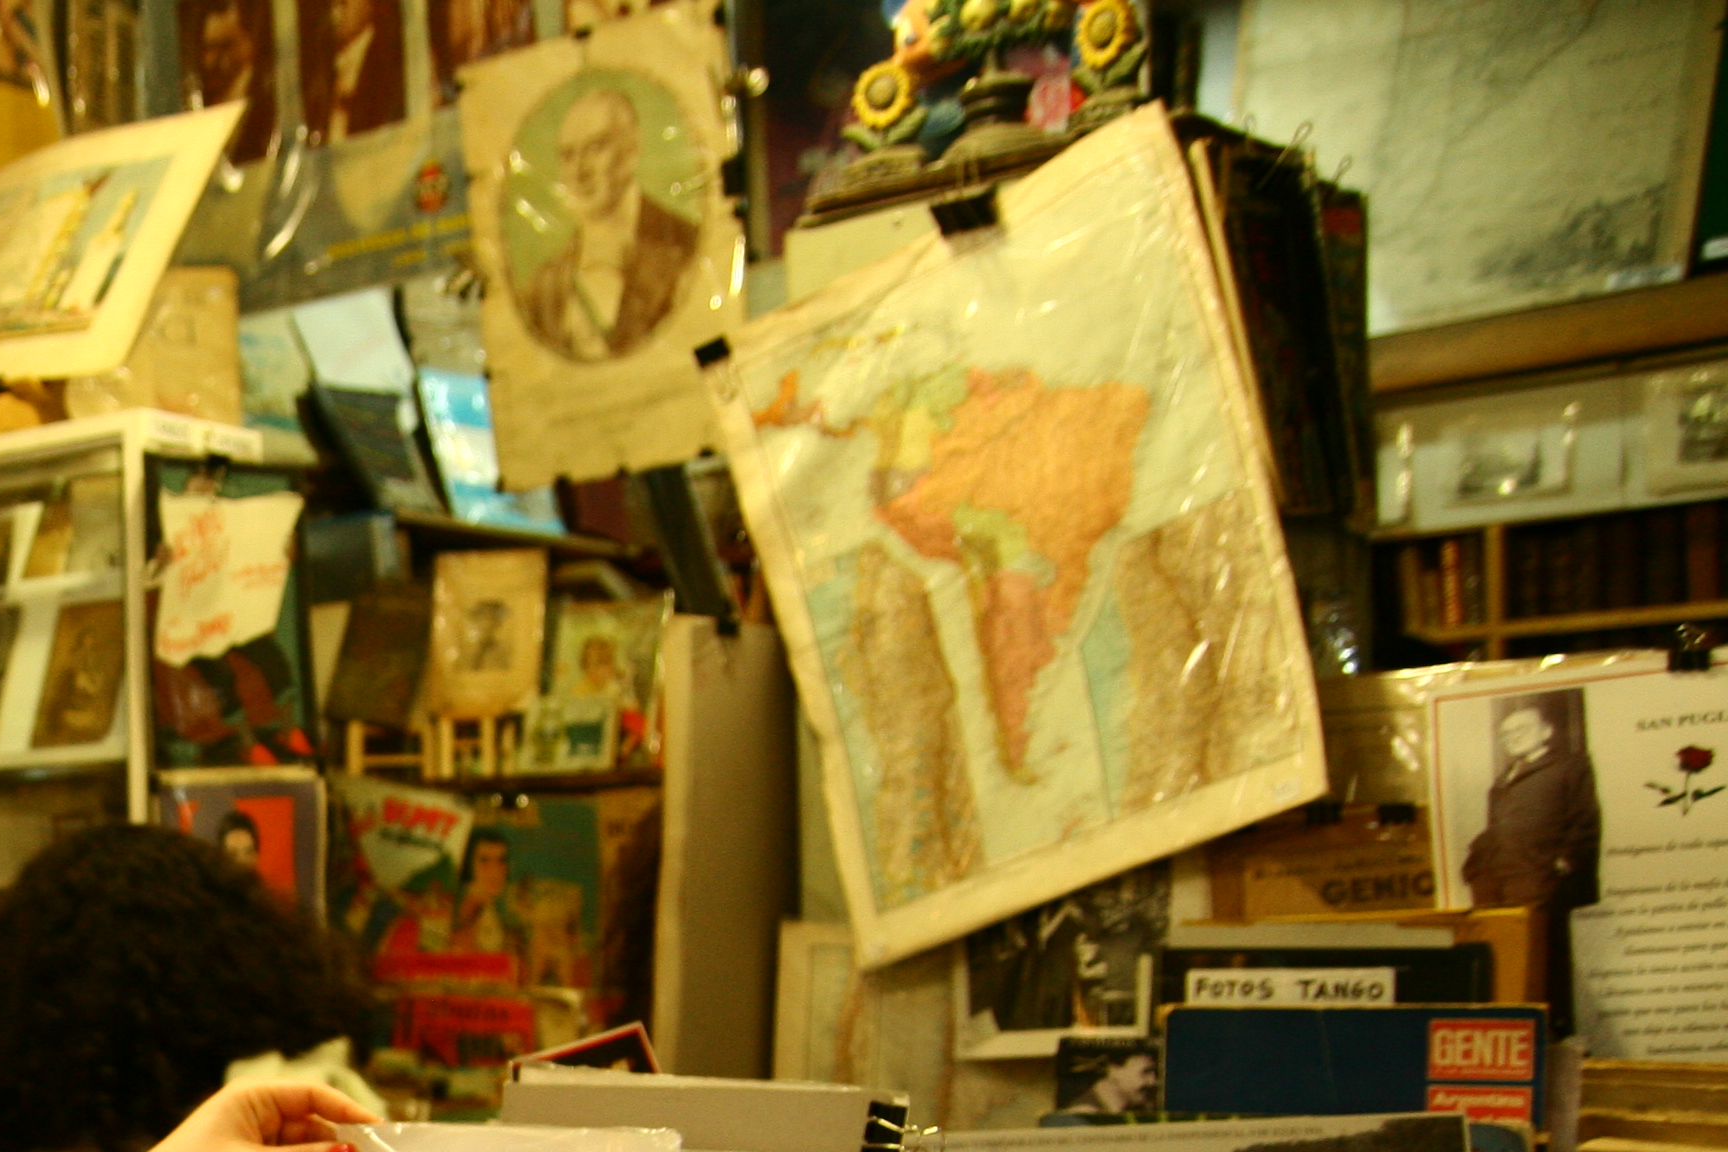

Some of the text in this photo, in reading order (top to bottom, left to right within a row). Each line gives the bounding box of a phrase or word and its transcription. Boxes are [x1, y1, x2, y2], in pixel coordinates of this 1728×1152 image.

[1194, 977, 1384, 1000] FOTOS TANGO
[1434, 1029, 1529, 1066] GENTE
